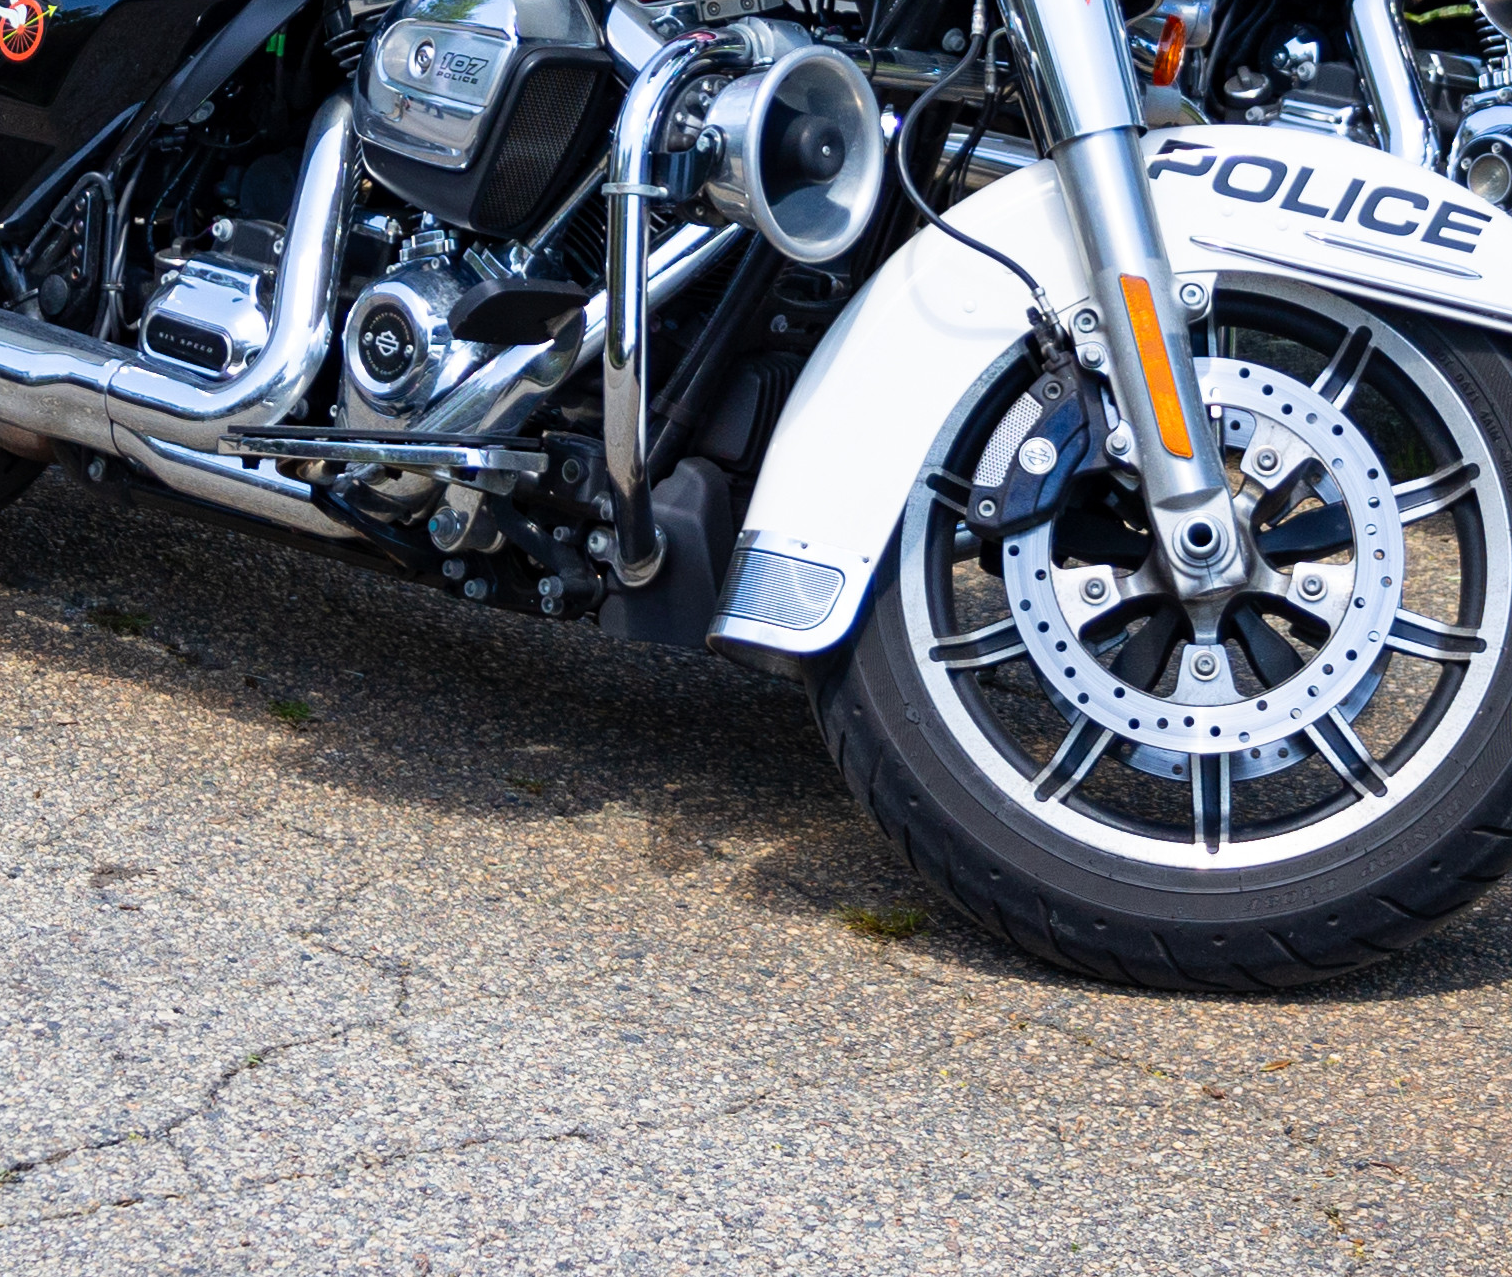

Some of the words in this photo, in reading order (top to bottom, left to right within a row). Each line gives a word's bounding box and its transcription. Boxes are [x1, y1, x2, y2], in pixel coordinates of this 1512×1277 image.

[440, 52, 489, 76] 107
[436, 70, 479, 85] POLICE
[1147, 138, 1492, 254] POLICE
[180, 338, 214, 354] SPEED
